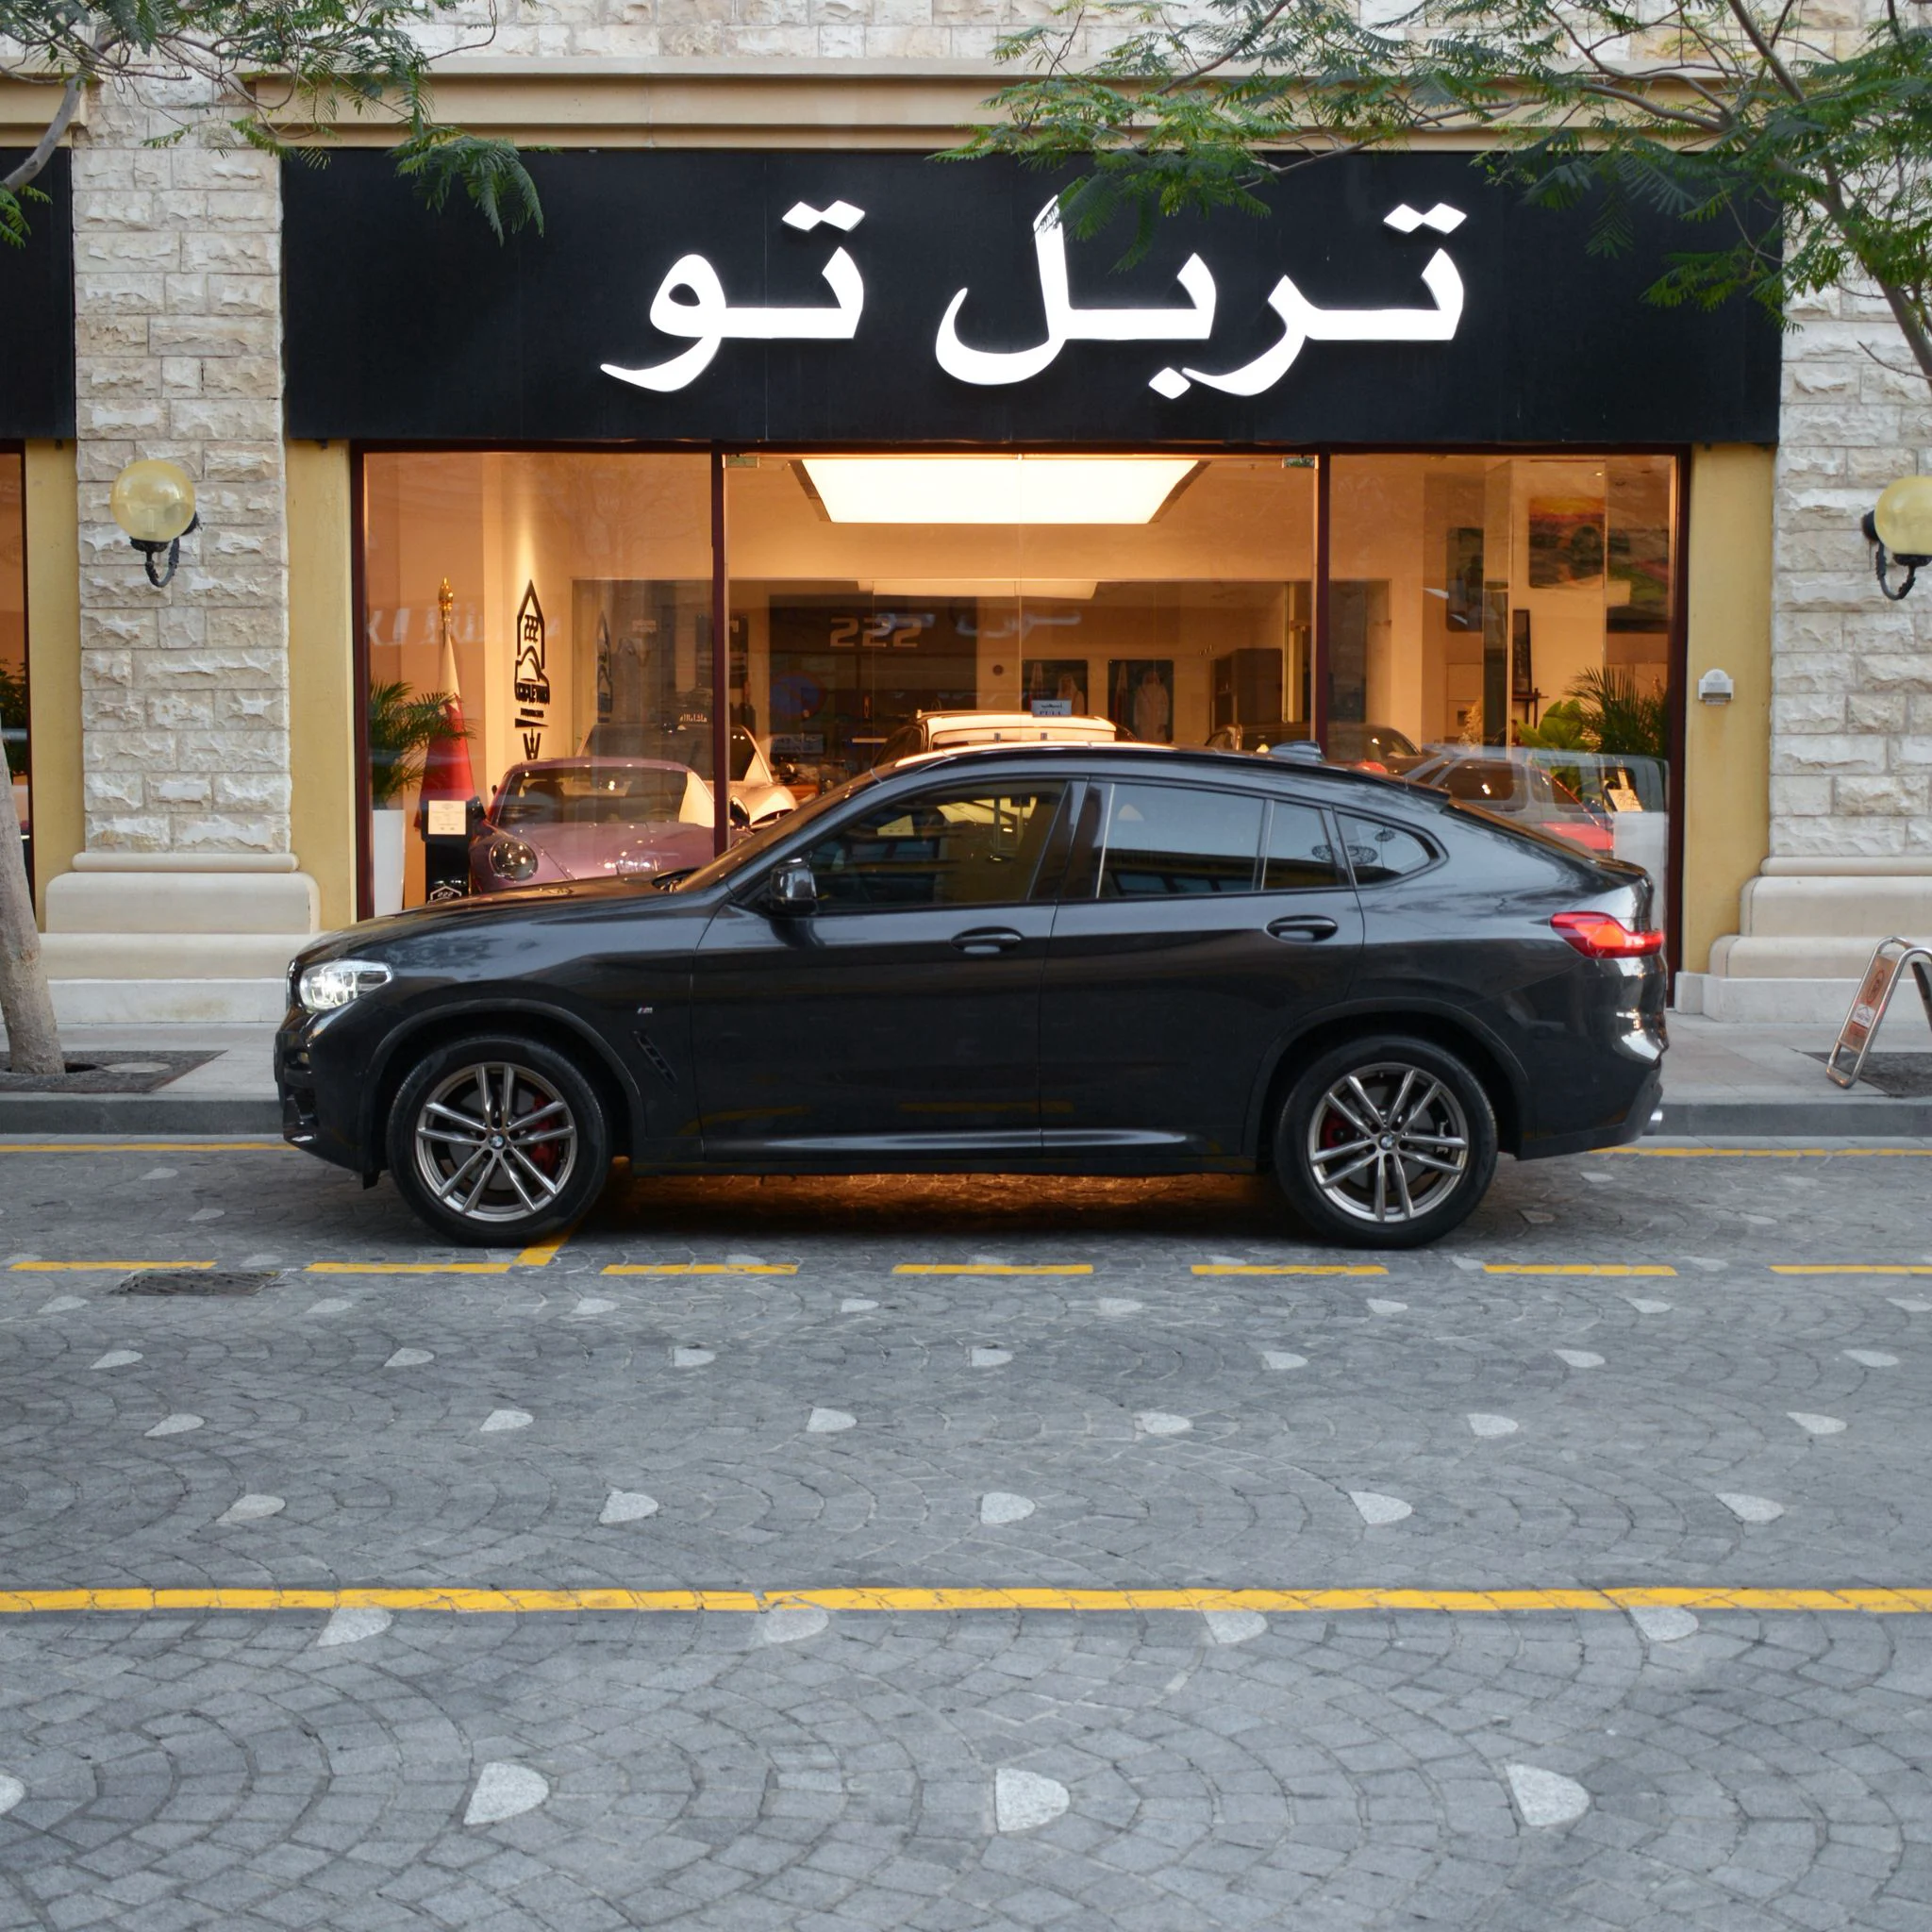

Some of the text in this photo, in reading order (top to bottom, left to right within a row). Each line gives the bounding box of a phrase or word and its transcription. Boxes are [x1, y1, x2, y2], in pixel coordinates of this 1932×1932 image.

[600, 194, 1468, 399] تربل تو
[829, 617, 923, 648] 222
